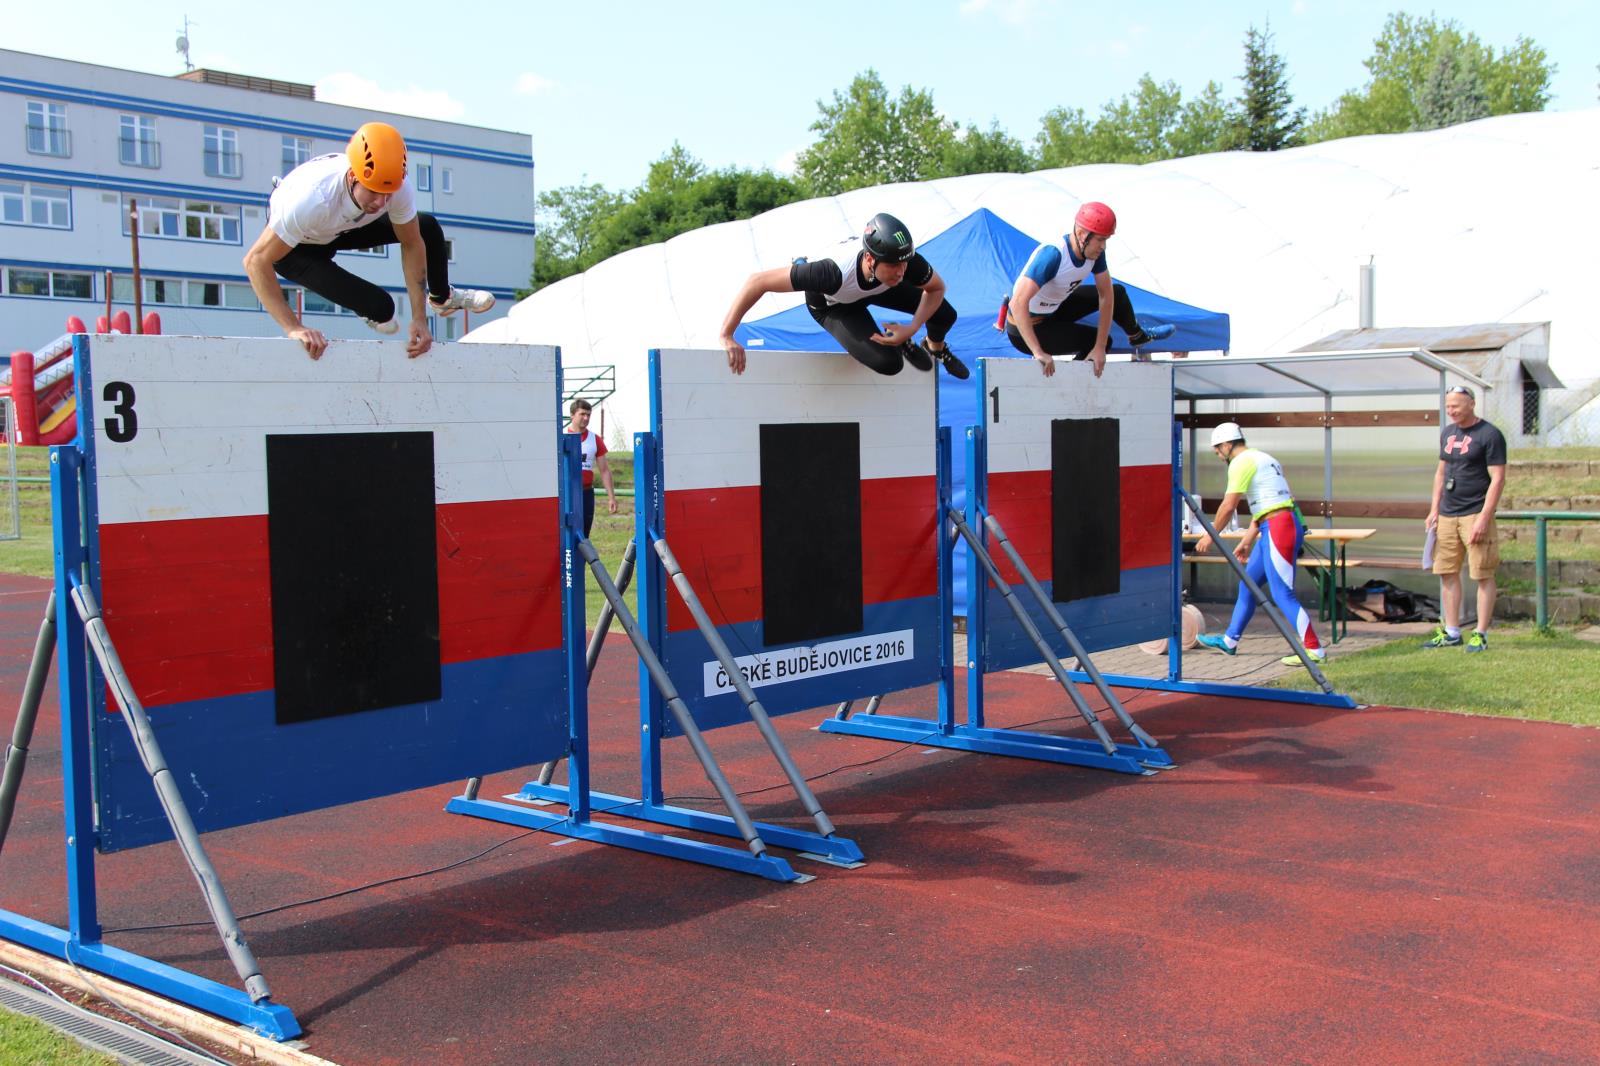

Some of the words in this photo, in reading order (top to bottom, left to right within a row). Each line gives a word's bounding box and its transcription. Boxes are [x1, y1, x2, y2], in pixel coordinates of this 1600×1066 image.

[103, 381, 138, 443] 3
[989, 386, 999, 424] 1
[716, 658, 772, 688] ČSKÉ
[776, 646, 871, 677] BUDĚJOVICE
[876, 641, 904, 659] 2016
